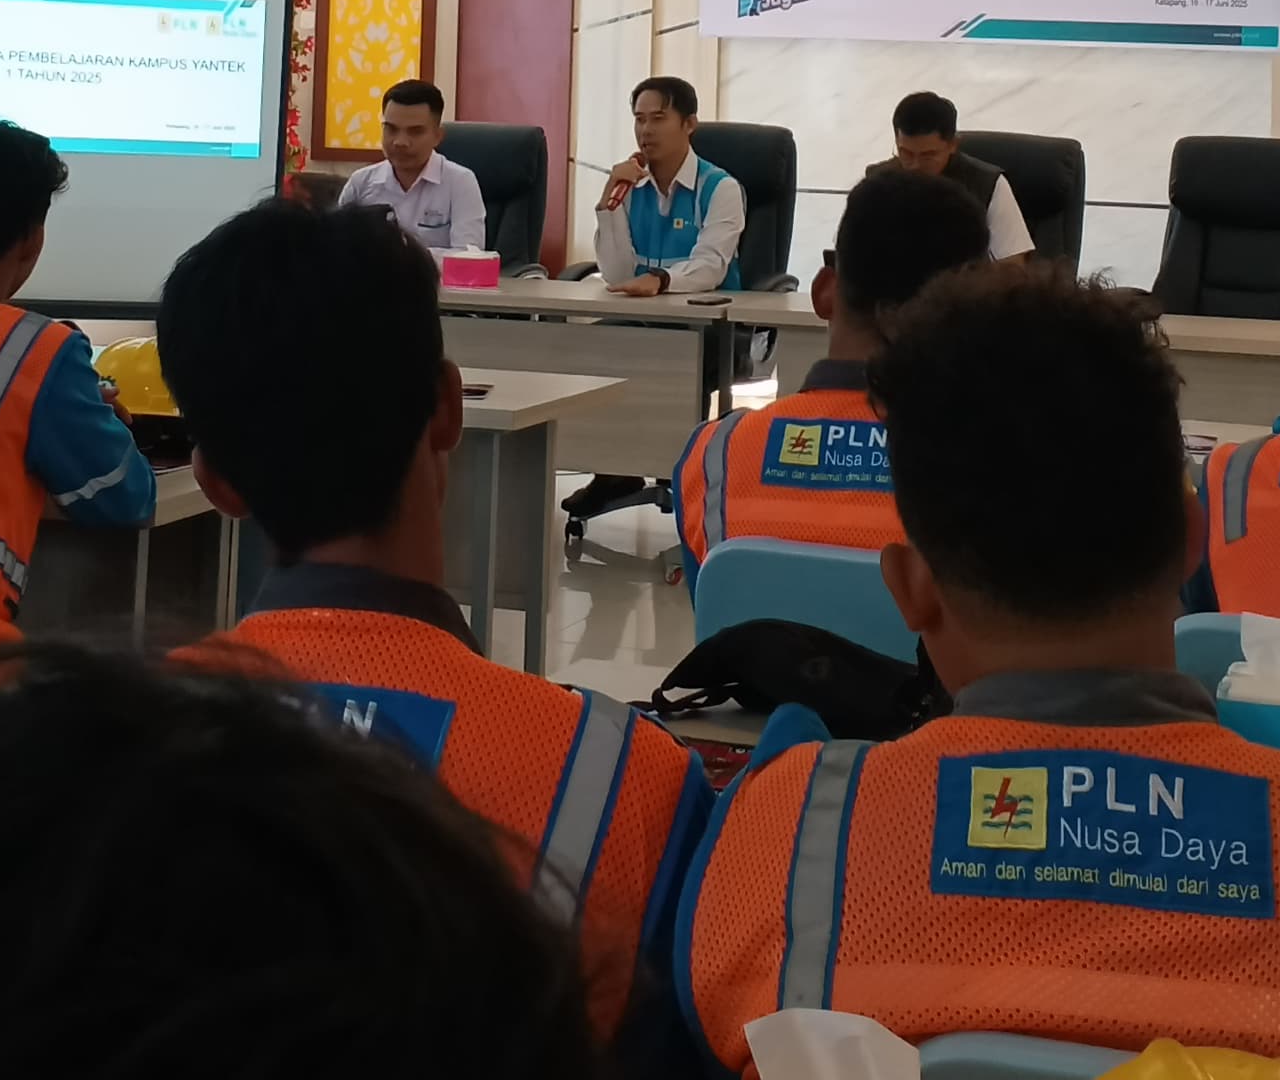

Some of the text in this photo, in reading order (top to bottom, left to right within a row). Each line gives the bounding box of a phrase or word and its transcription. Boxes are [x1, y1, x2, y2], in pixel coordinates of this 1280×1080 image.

[9, 50, 124, 67] PEMBELAJARAN
[129, 56, 187, 70] KAMPUS
[192, 59, 246, 73] YANTEK
[17, 68, 66, 82] TAHUN
[71, 70, 102, 84] 2025
[827, 425, 888, 447] PLN
[824, 450, 890, 468] Nusa Da
[1063, 766, 1184, 819] PLN
[1060, 817, 1248, 870] Nusa Daya
[940, 858, 1260, 903] Aman dan selamat dimulai dari saya
